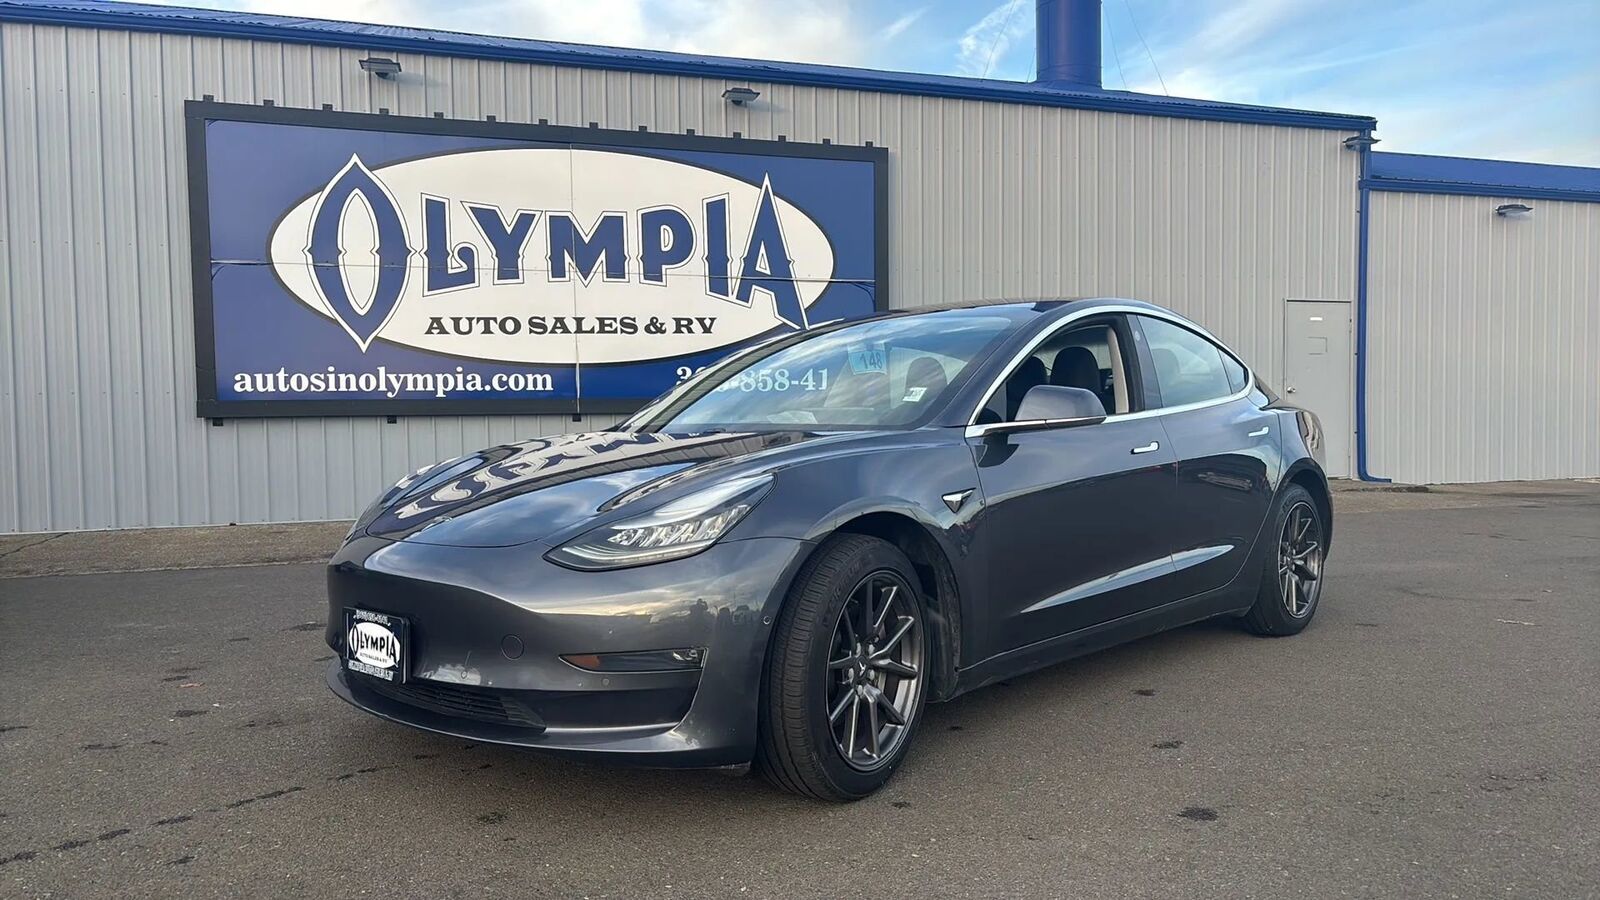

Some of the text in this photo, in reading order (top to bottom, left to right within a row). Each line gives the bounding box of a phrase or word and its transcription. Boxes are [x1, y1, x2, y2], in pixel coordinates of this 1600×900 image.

[303, 153, 812, 353] OLYMPIA
[424, 316, 717, 335] AUTO SALES & RV
[860, 352, 883, 370] 148
[233, 366, 554, 397] autosinolympia.com
[351, 622, 399, 668] OLYMPIA
